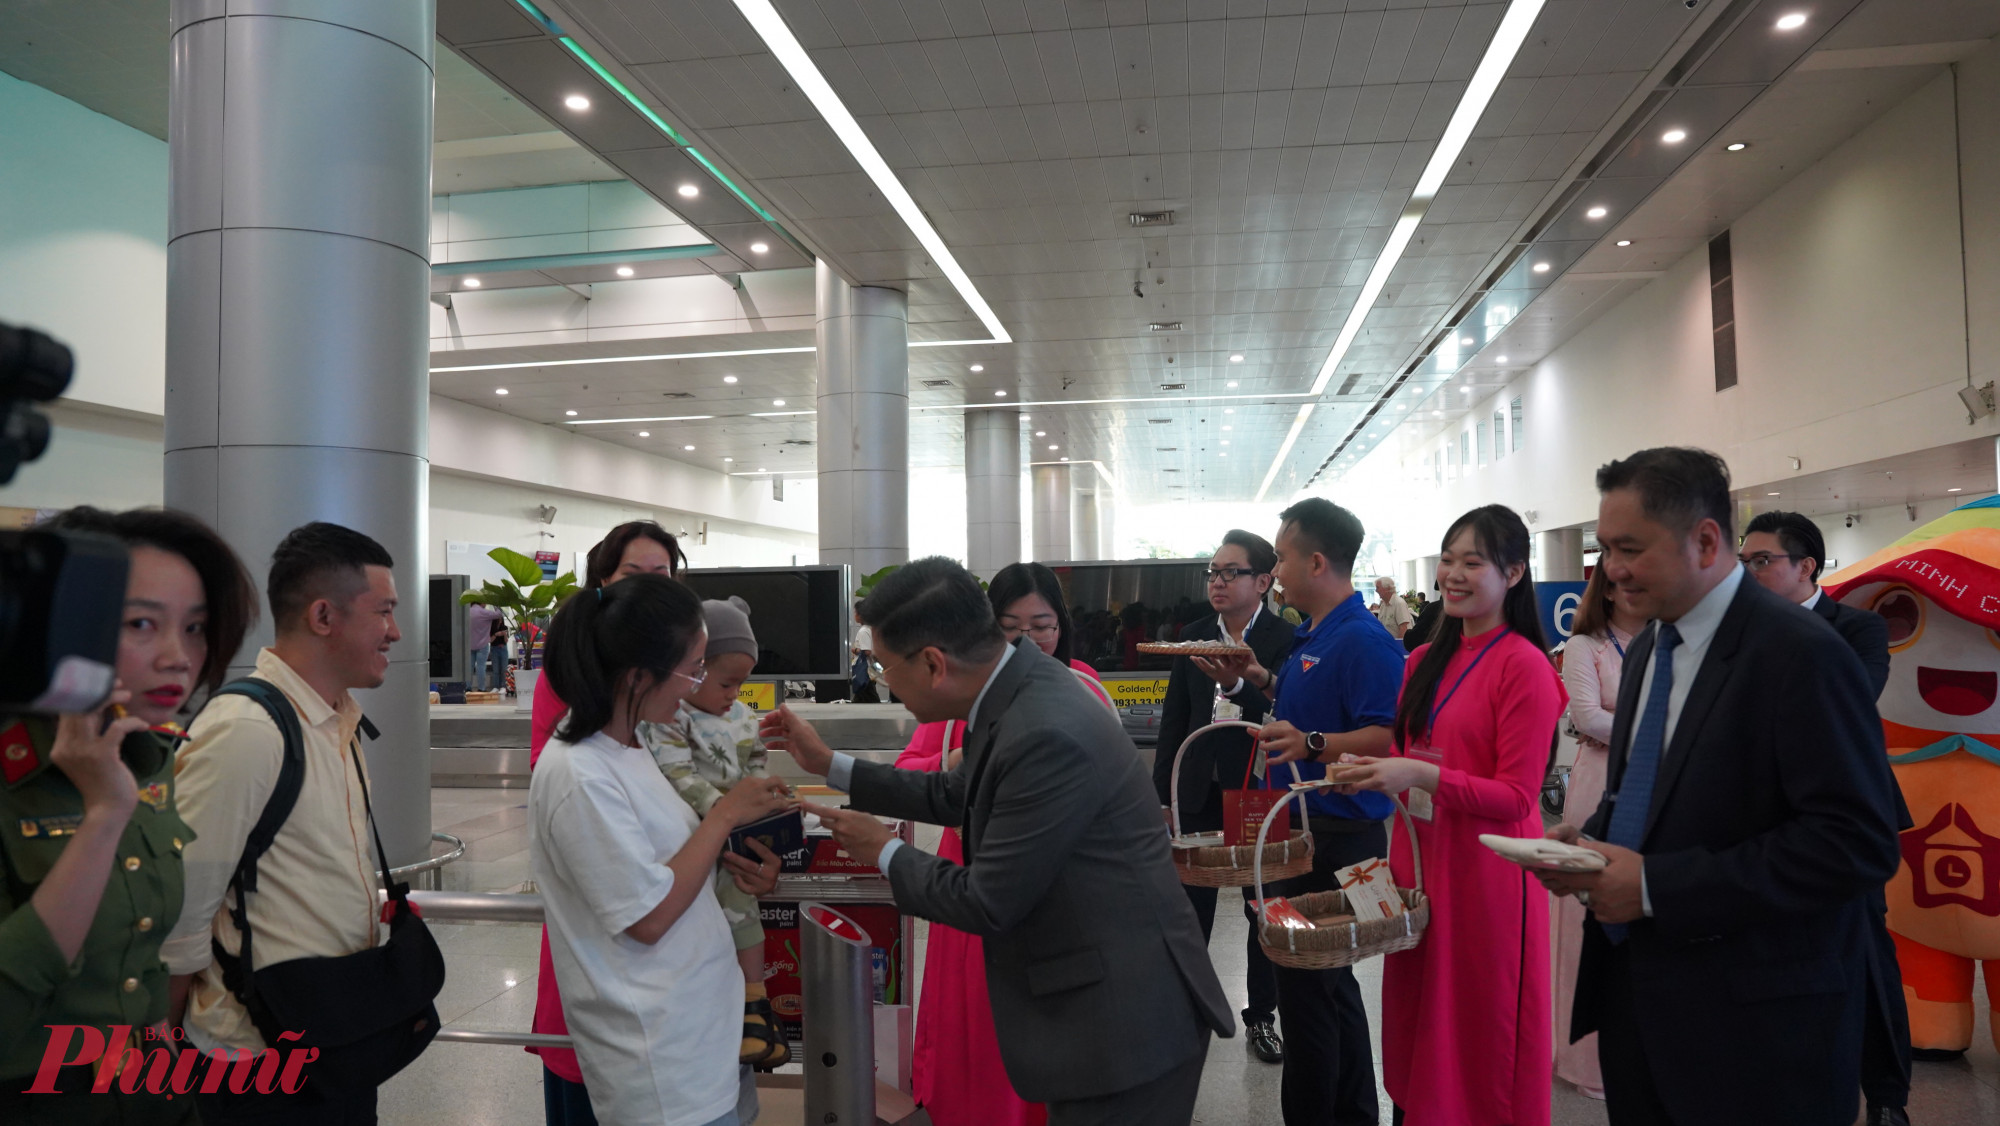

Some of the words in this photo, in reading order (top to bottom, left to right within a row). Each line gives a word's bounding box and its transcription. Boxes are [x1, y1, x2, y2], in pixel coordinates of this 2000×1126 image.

[1896, 560, 1968, 598] MINH
[1980, 595, 2000, 613] C
[1554, 592, 1582, 637] 6
[738, 689, 753, 697] and
[786, 860, 802, 868] paint
[760, 907, 796, 920] aster
[872, 952, 884, 960] ster
